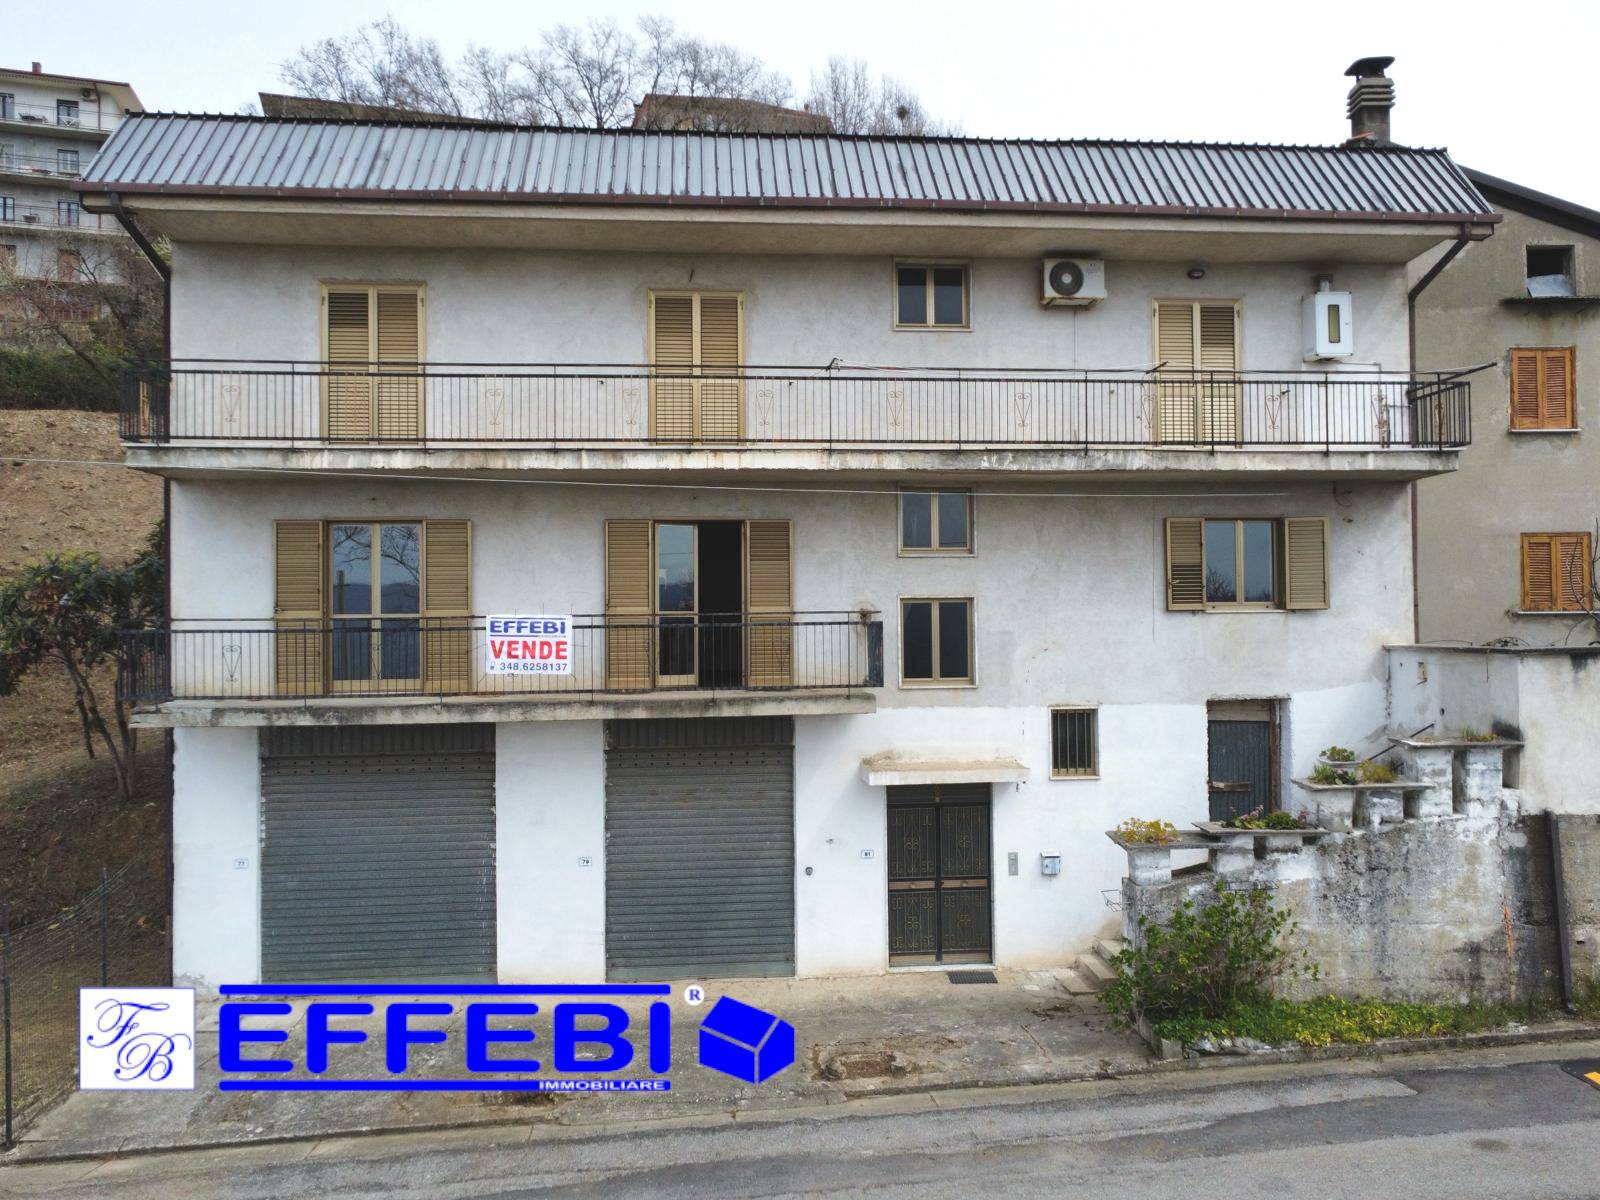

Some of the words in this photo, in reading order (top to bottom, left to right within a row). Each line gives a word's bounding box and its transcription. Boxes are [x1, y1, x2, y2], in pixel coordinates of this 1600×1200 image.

[490, 620, 566, 634] EFFEBI
[490, 639, 567, 660] VENDE
[499, 662, 568, 671] 348.6258137
